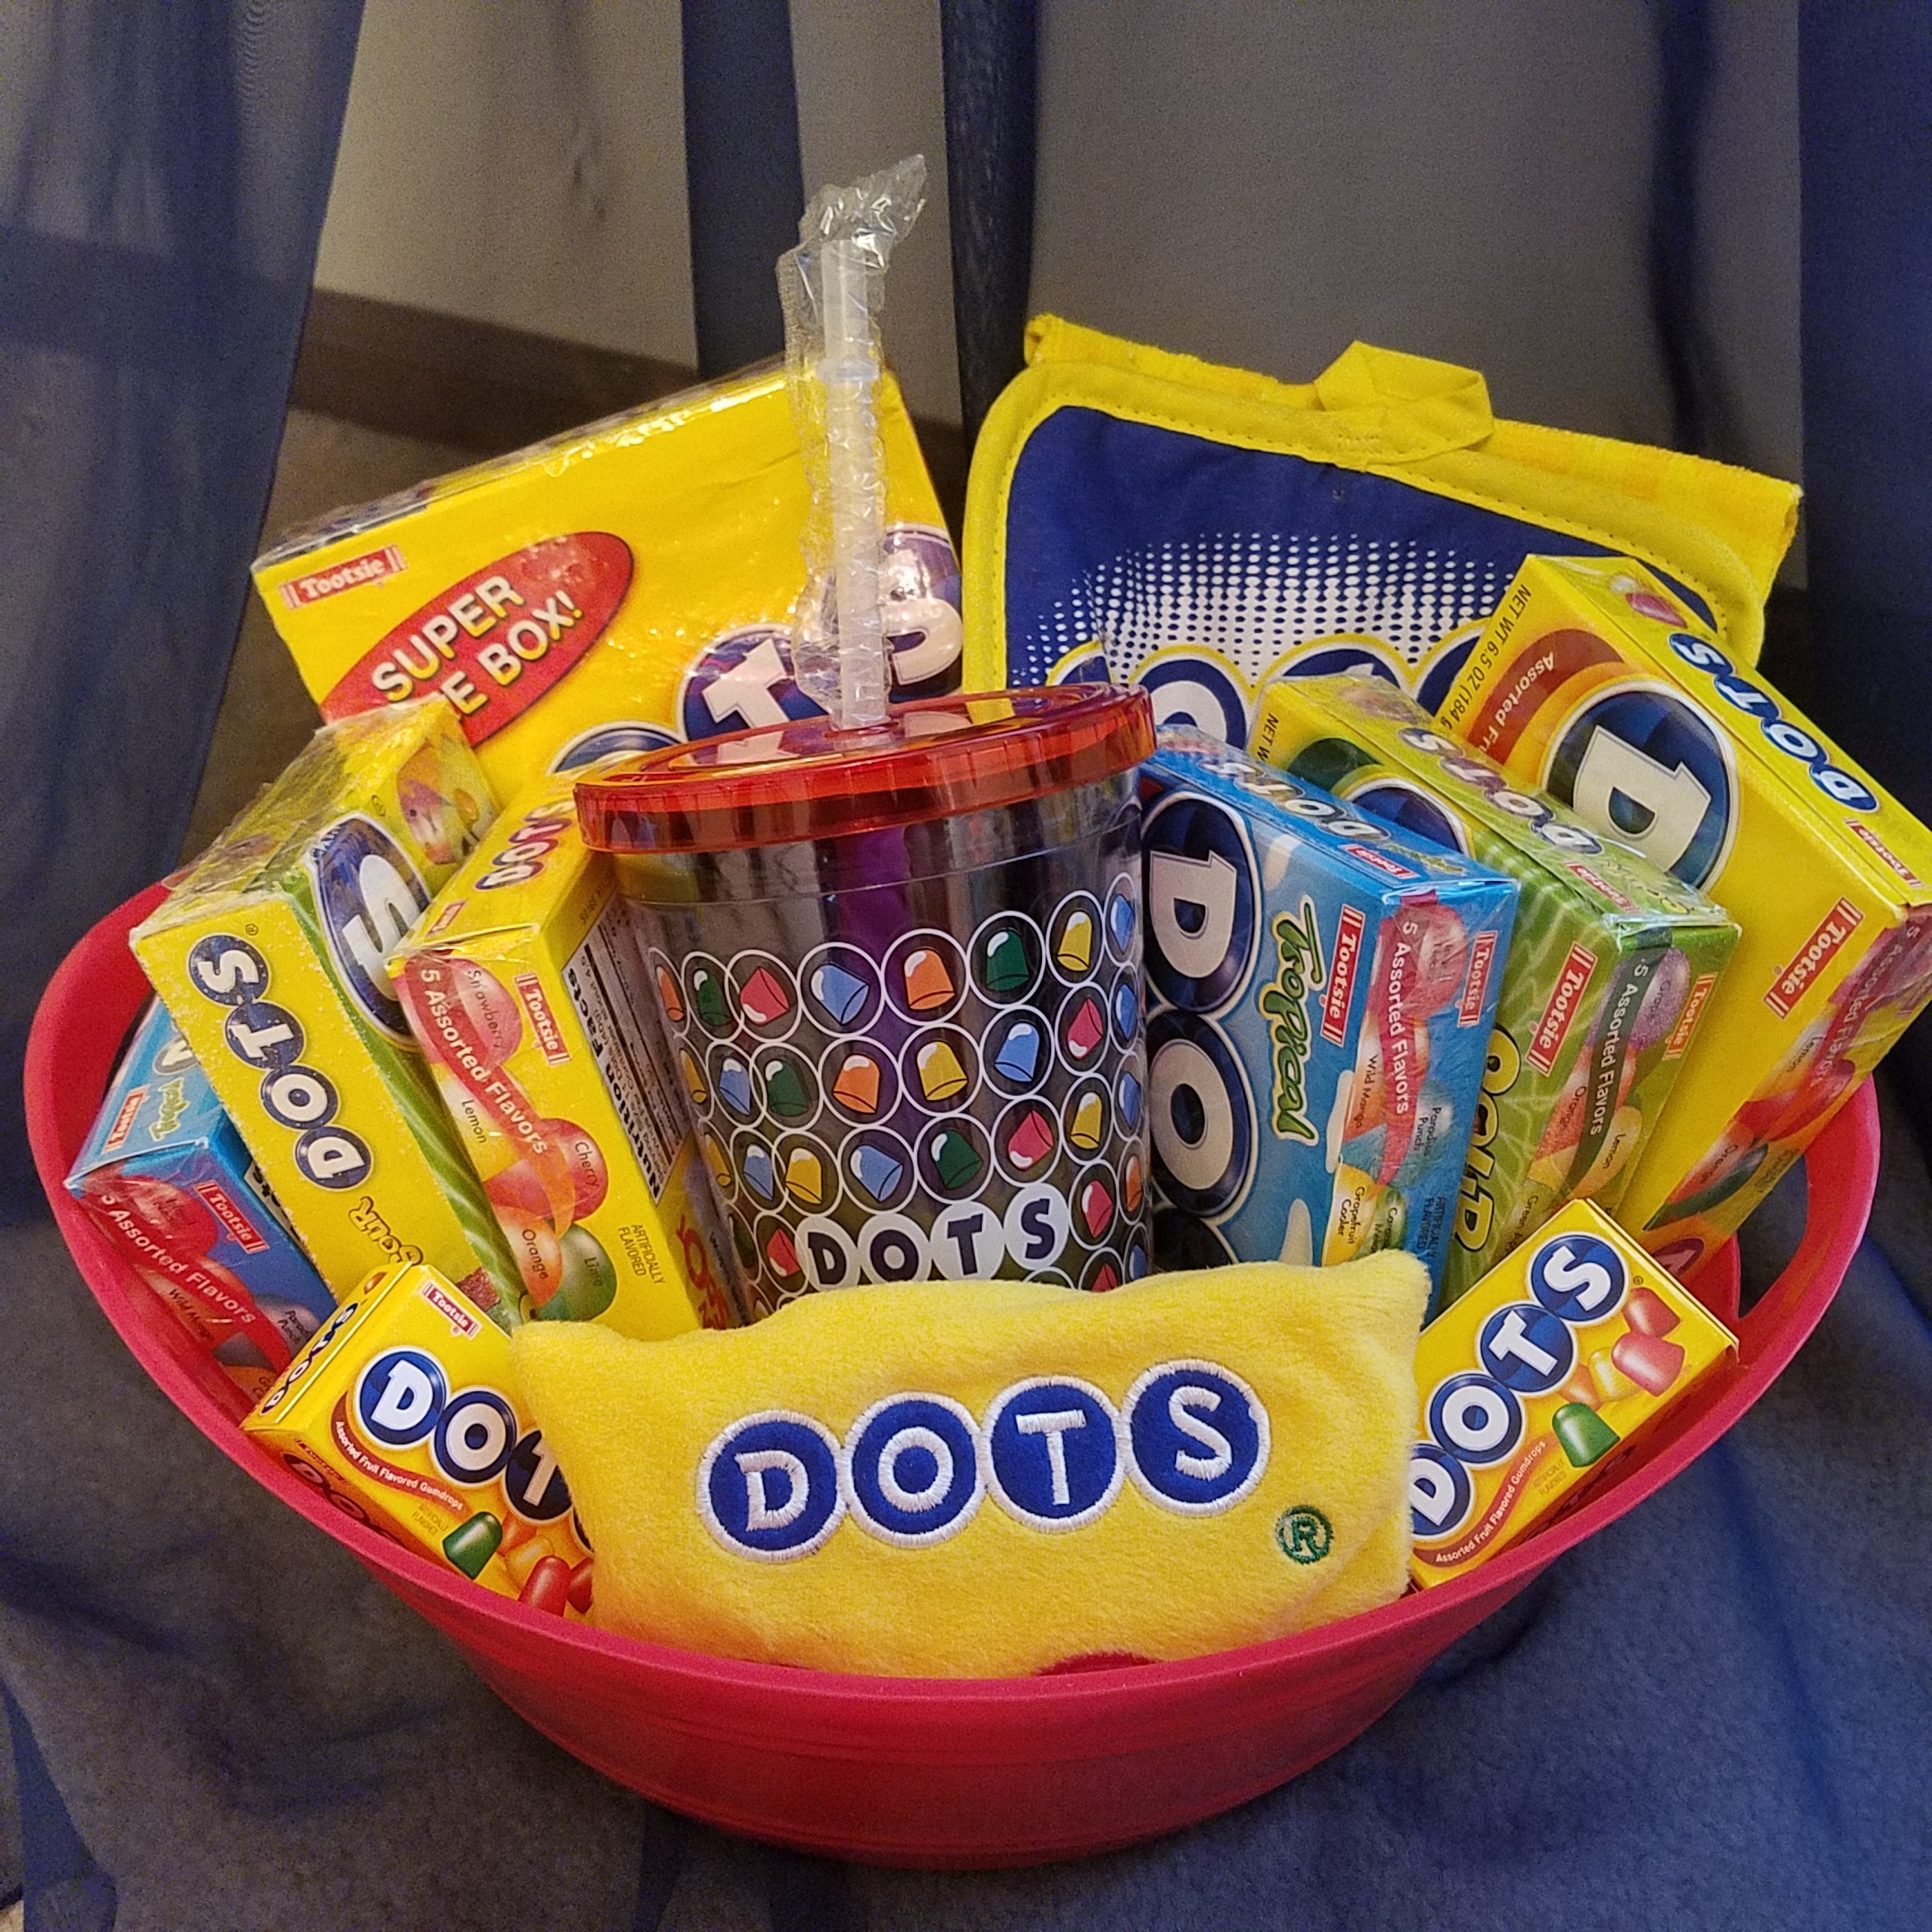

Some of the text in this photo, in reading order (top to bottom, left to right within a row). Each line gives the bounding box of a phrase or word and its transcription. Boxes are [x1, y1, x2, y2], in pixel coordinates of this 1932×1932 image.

[299, 556, 386, 600] Tootsie
[1510, 584, 1532, 620] NET
[372, 576, 524, 702] SUPER
[477, 590, 583, 686] BOX!
[1480, 640, 1499, 669] 6.5
[1496, 616, 1514, 646] WT
[1467, 666, 1485, 691] OZ
[1495, 651, 1554, 727] Assorted
[1264, 713, 1278, 746] NET
[1678, 639, 1871, 804] DOTS
[1401, 729, 1600, 852] DOTS
[1860, 828, 1909, 878] Tootsie
[420, 969, 441, 983] 5
[1330, 930, 1357, 1019] Tootsie
[1465, 946, 1489, 1010] Tootsie
[1782, 920, 1847, 997] Tootsie
[424, 989, 490, 1082] Assorted
[523, 988, 559, 1050] Tootsie
[568, 968, 604, 1057] Facts
[1259, 894, 1326, 1146] Tropical
[1388, 921, 1419, 1114] 5 Assorted Flavors
[1539, 969, 1584, 1049] Tootsie
[1673, 987, 1706, 1046] Tootsie
[196, 947, 368, 1181] DOTS
[1589, 963, 1648, 1136] 5 Assorted Flavors
[462, 1098, 487, 1145] Lemon
[485, 1080, 547, 1156] Flavors
[1355, 1055, 1378, 1129] Wild Mango
[574, 1140, 600, 1189] Cherry
[606, 1063, 661, 1199] Nutrition
[1414, 1117, 1428, 1151] Punch
[209, 1193, 252, 1241] Tootsie
[617, 1226, 646, 1277] FLAVORED
[808, 1198, 1055, 1284] DOTS
[1337, 1199, 1352, 1236] Cooler
[1347, 1186, 1366, 1244] Grapefruit
[108, 1209, 191, 1275] Assorted
[185, 1270, 256, 1324] Flavors
[521, 1228, 549, 1280] Orange
[584, 1256, 603, 1288] Lime
[631, 1224, 665, 1284] ARTIFICIALLY
[431, 1290, 469, 1329] Tootsie
[266, 1304, 356, 1411] DOTS
[1411, 1245, 1611, 1526] DOTS
[335, 1421, 462, 1511] Assorted Fruit Flavored Gumdrops
[370, 1359, 561, 1507] DOT
[735, 1384, 1234, 1532] DOTS
[1436, 1441, 1546, 1563] Assorted Fruit Flavored Gumdrops
